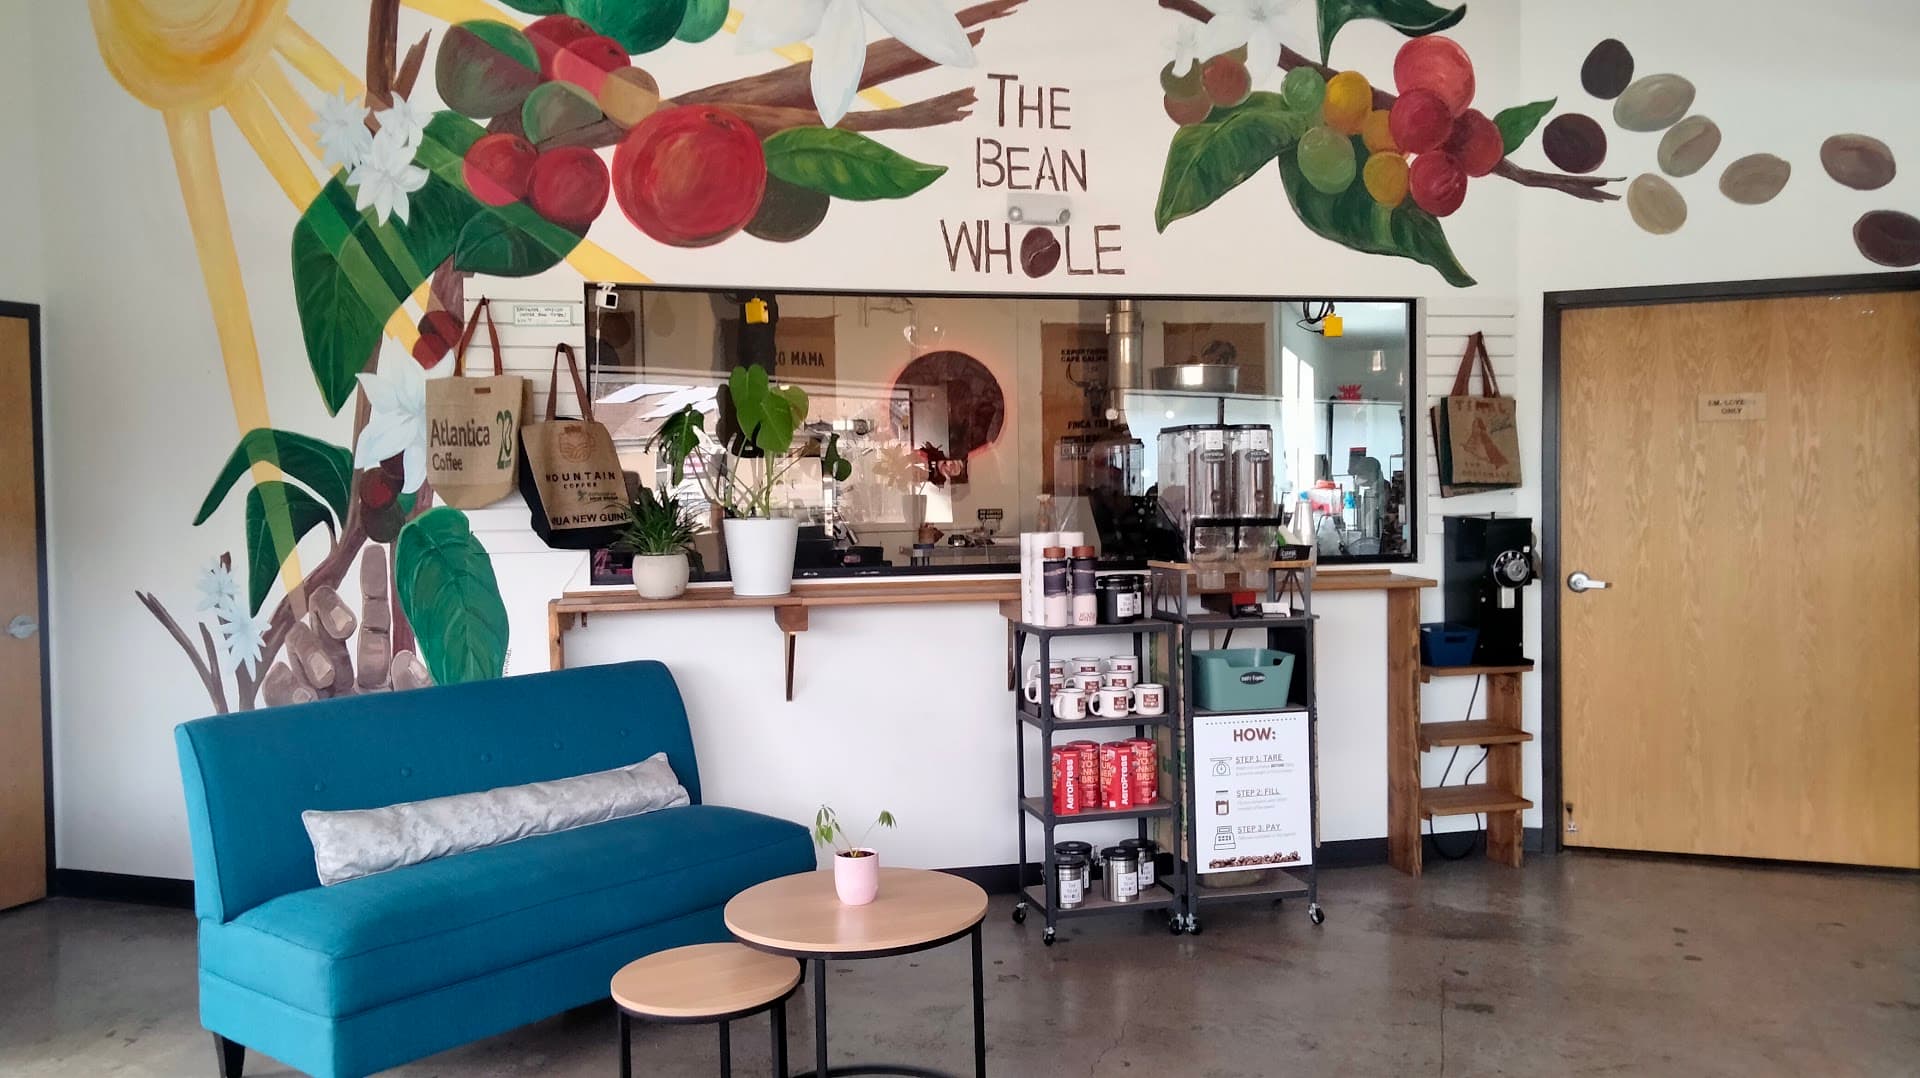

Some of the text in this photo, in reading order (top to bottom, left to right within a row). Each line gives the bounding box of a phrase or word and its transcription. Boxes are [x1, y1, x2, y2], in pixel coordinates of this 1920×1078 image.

[987, 73, 1071, 130] THE
[976, 136, 1088, 192] BEAN
[791, 355, 825, 368] MAMA
[430, 418, 491, 448] Atlantica
[432, 451, 464, 471] Coffee
[573, 513, 598, 523] NEW
[1233, 727, 1276, 742] HOW:
[1235, 755, 1255, 764] STEP
[1236, 789, 1255, 798] STEP
[1264, 786, 1280, 796] FILL
[1237, 825, 1256, 834] STEP
[1265, 823, 1281, 832] PAY
